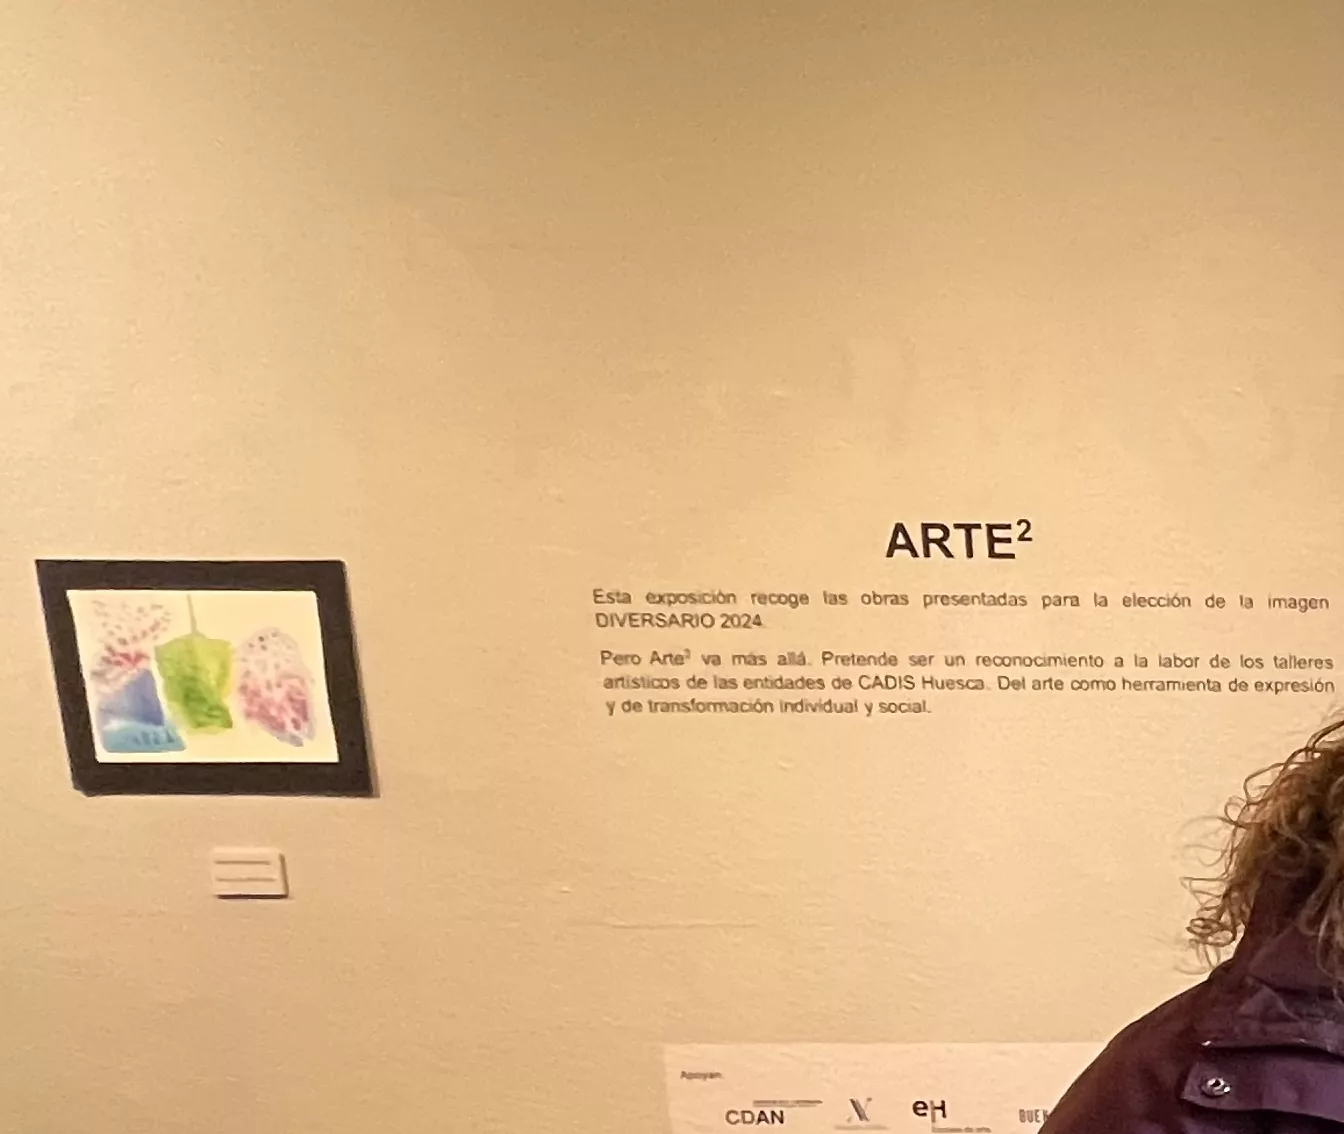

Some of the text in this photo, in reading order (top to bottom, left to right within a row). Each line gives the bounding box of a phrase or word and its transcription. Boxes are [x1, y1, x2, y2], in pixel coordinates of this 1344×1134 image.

[593, 588, 1330, 613] Esta exposición recoge las obras presentadas para la elección de la imagen
[594, 612, 716, 629] DIVERSARIO
[600, 650, 642, 666] Pero
[701, 654, 721, 667] va
[822, 650, 899, 667] Pretende
[908, 655, 935, 667] ser
[944, 655, 965, 667] un
[975, 652, 1104, 667] reconocimiento
[1114, 656, 1124, 668] a
[1134, 653, 1148, 668] la
[1158, 653, 1200, 668] labor
[1209, 654, 1231, 669] de
[1240, 655, 1264, 669] los
[1273, 653, 1334, 670] talleres
[603, 675, 680, 689] artísticos
[686, 674, 708, 689] de
[712, 676, 738, 690] las
[743, 675, 825, 690] entidades
[831, 676, 853, 690] de
[858, 674, 915, 690] CADIS
[997, 676, 1026, 691] Del
[1032, 677, 1064, 691] arte
[1071, 679, 1116, 691] como
[1122, 676, 1222, 692] herramienta
[1228, 678, 1249, 692] de
[1254, 677, 1335, 695] expresión
[605, 698, 932, 717] y de transformación individual y social.
[725, 1109, 784, 1125] CDAN
